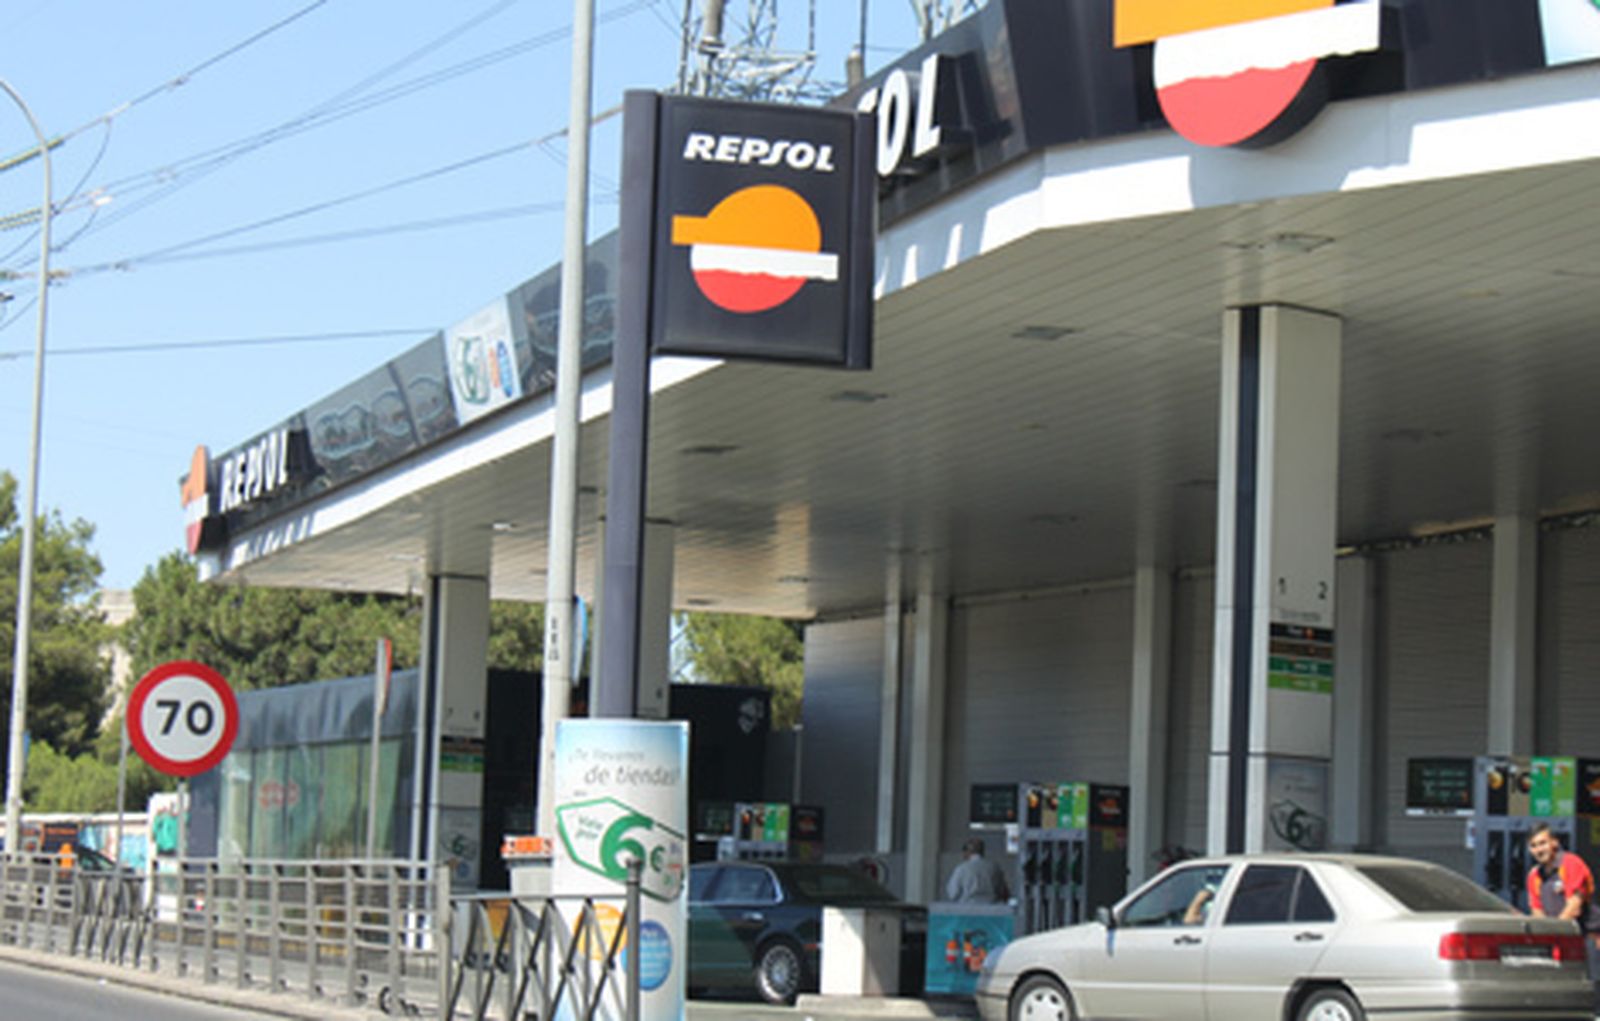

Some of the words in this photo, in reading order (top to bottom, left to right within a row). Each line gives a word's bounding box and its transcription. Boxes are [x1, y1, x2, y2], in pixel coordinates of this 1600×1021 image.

[857, 53, 940, 177] OL
[683, 133, 835, 172] REPSOL
[219, 429, 287, 514] REPSOL
[1317, 581, 1328, 600] 2
[156, 700, 214, 736] 70
[584, 764, 610, 785] de
